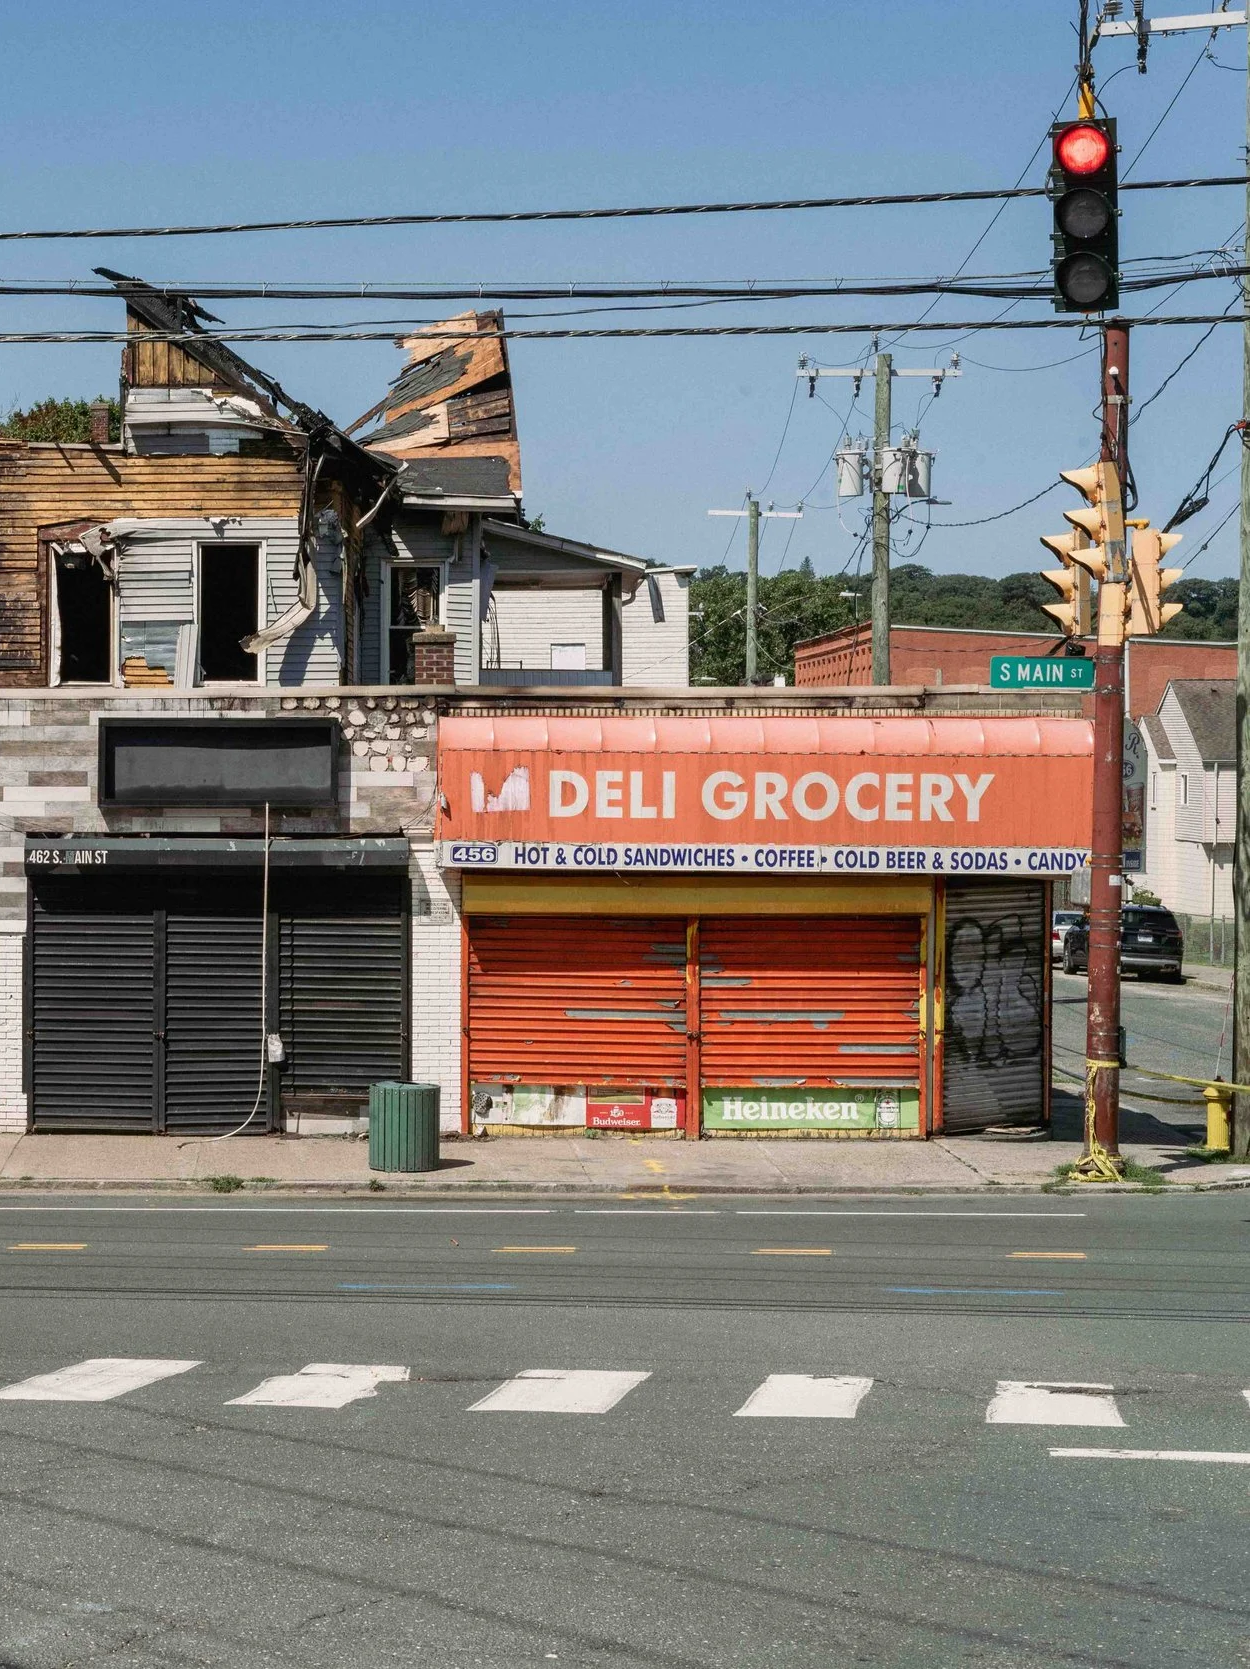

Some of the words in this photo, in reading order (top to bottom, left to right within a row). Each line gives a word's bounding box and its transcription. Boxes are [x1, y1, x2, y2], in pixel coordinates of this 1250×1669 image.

[999, 662, 1011, 682] S
[1017, 663, 1064, 682] MAIN
[1070, 668, 1083, 678] ST
[548, 770, 676, 819] DELI
[701, 770, 996, 823] GROCERY
[29, 849, 50, 864] 462
[52, 850, 63, 864] S.
[94, 850, 109, 864] ST
[452, 848, 496, 862] 456
[514, 847, 550, 865] HOT
[555, 848, 567, 865] &
[573, 848, 618, 866] COLD
[623, 848, 735, 867] SANDWICHES
[754, 849, 815, 868] COFFEE
[834, 850, 879, 869] COLD
[886, 851, 926, 869] BEER
[932, 852, 944, 870] &
[950, 851, 1008, 870] SODAS
[1027, 852, 1087, 871] CANDY
[721, 1096, 860, 1121] Heineken
